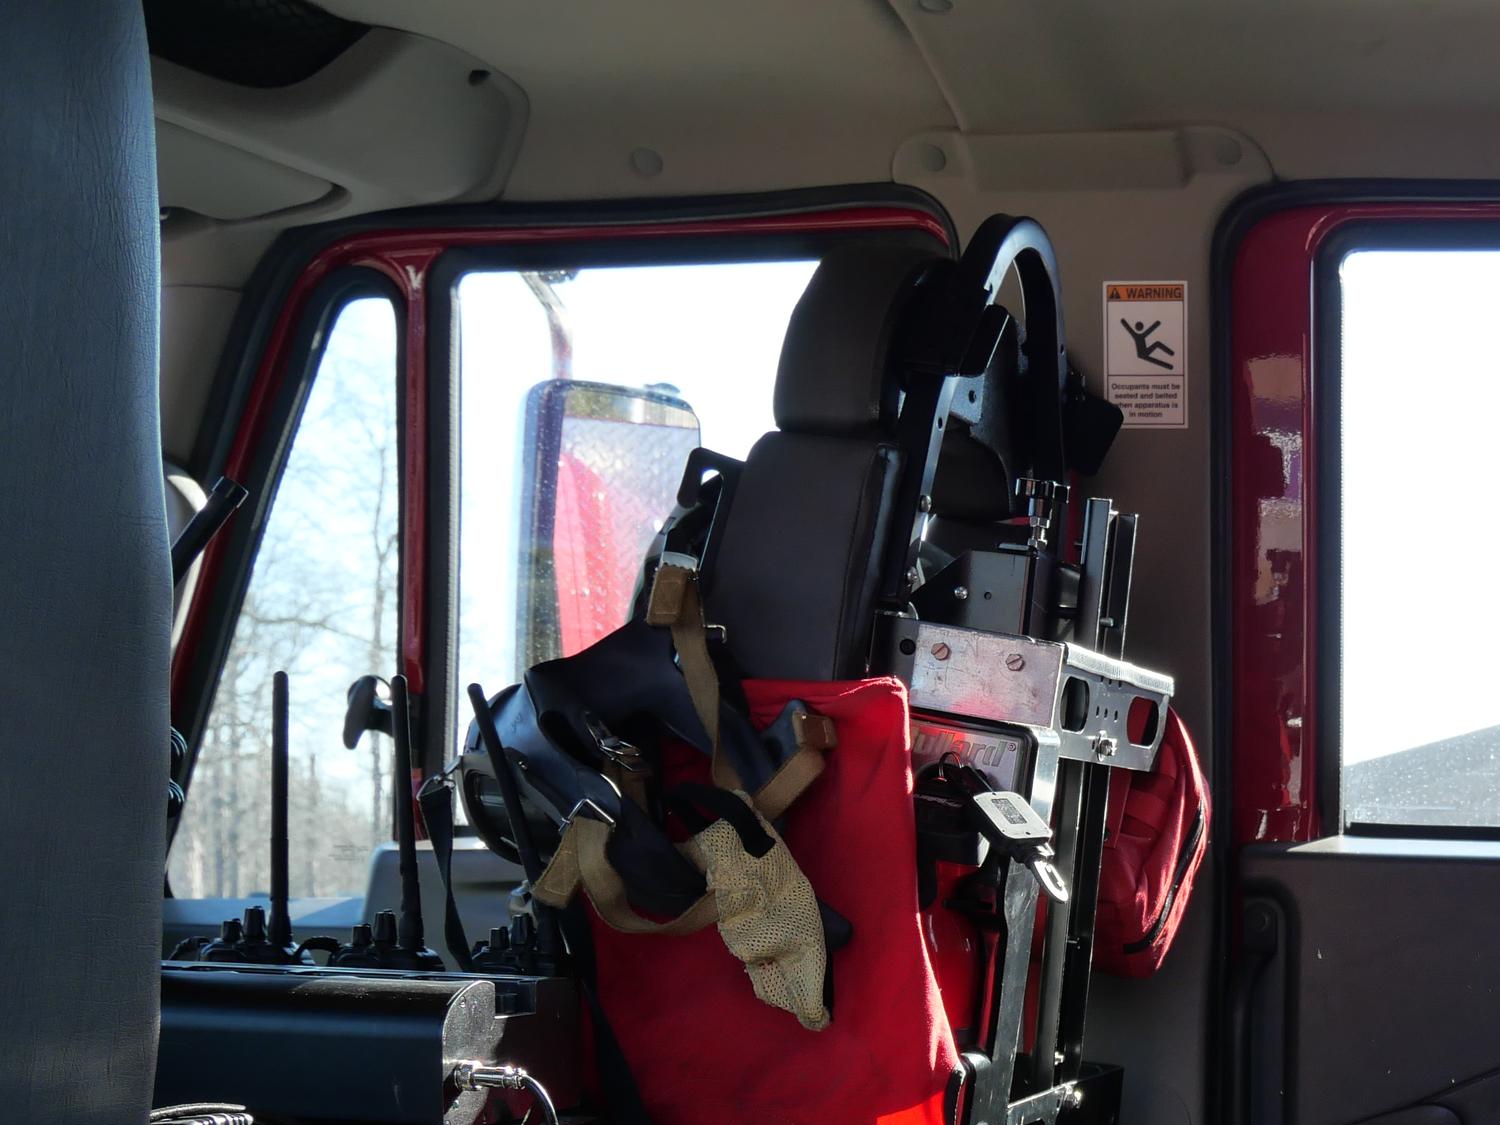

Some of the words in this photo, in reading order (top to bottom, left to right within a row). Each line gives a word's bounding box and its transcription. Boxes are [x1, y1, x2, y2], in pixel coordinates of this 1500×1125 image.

[1126, 287, 1182, 298] WARNING
[1111, 383, 1150, 391] Occupants
[1134, 402, 1170, 410] apparatus
